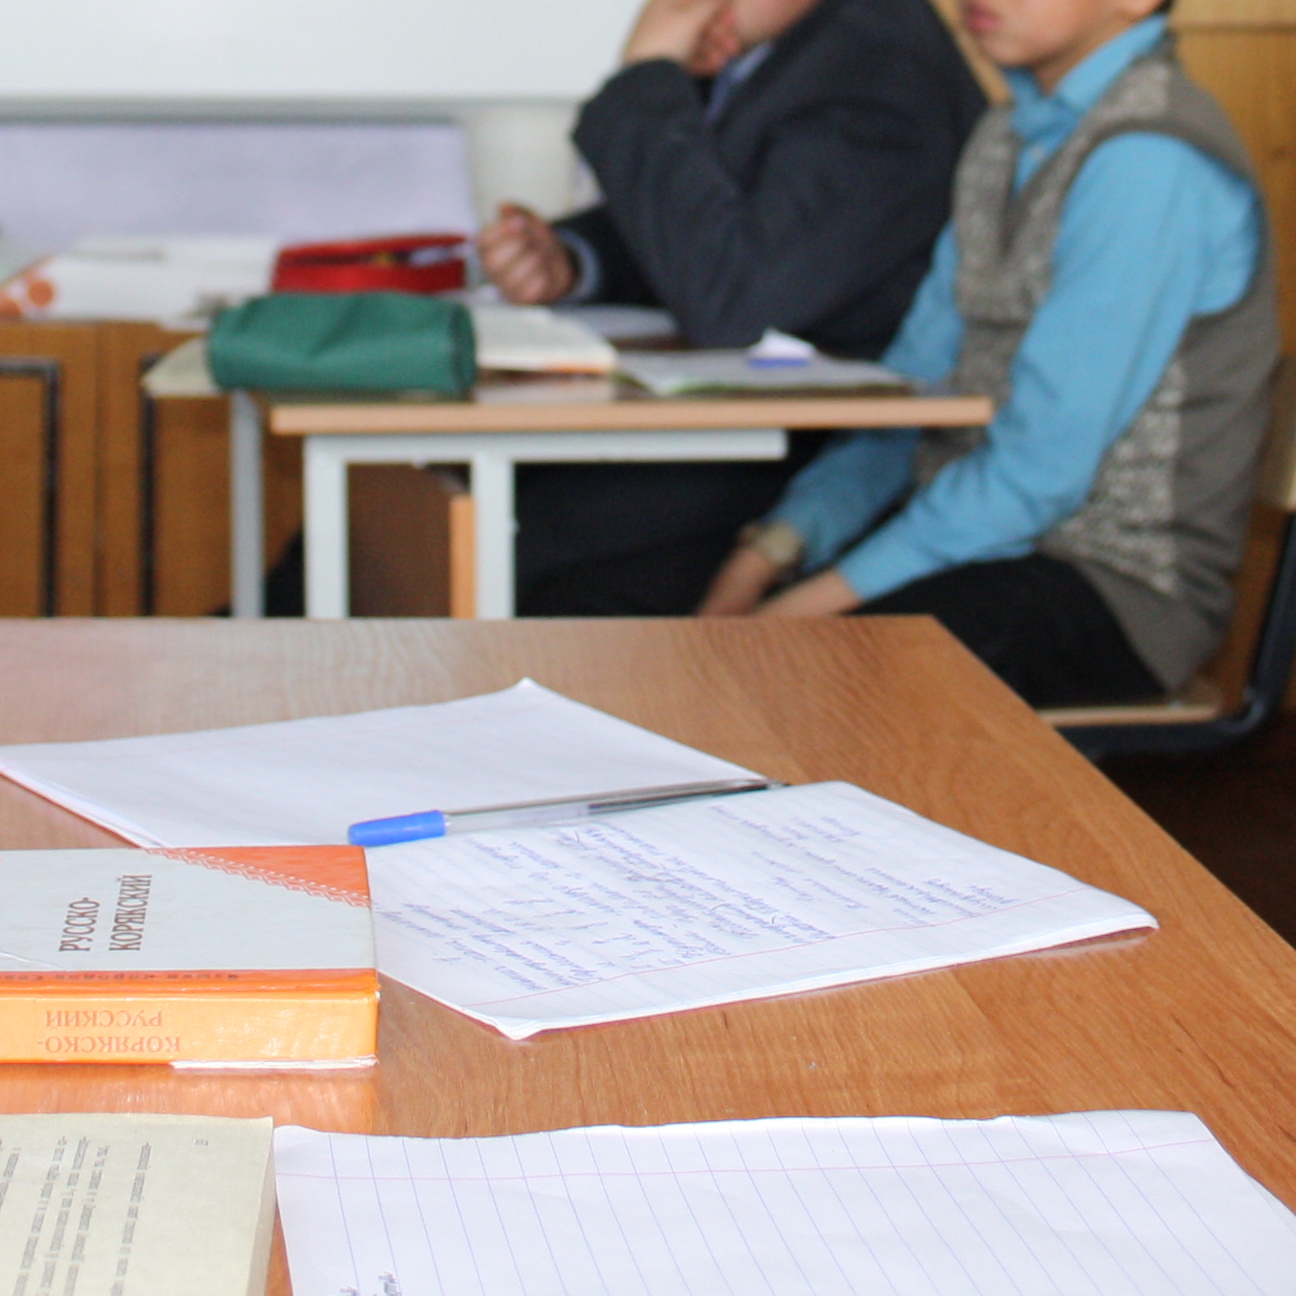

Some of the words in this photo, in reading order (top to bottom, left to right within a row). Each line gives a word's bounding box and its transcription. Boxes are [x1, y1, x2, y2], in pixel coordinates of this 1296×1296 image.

[58, 896, 101, 953] РУССКО-
[109, 873, 152, 952] КОРЯКСКИЙ
[45, 1010, 162, 1031] РУССКИЙ
[37, 1036, 180, 1054] КОРЯКСКО-
